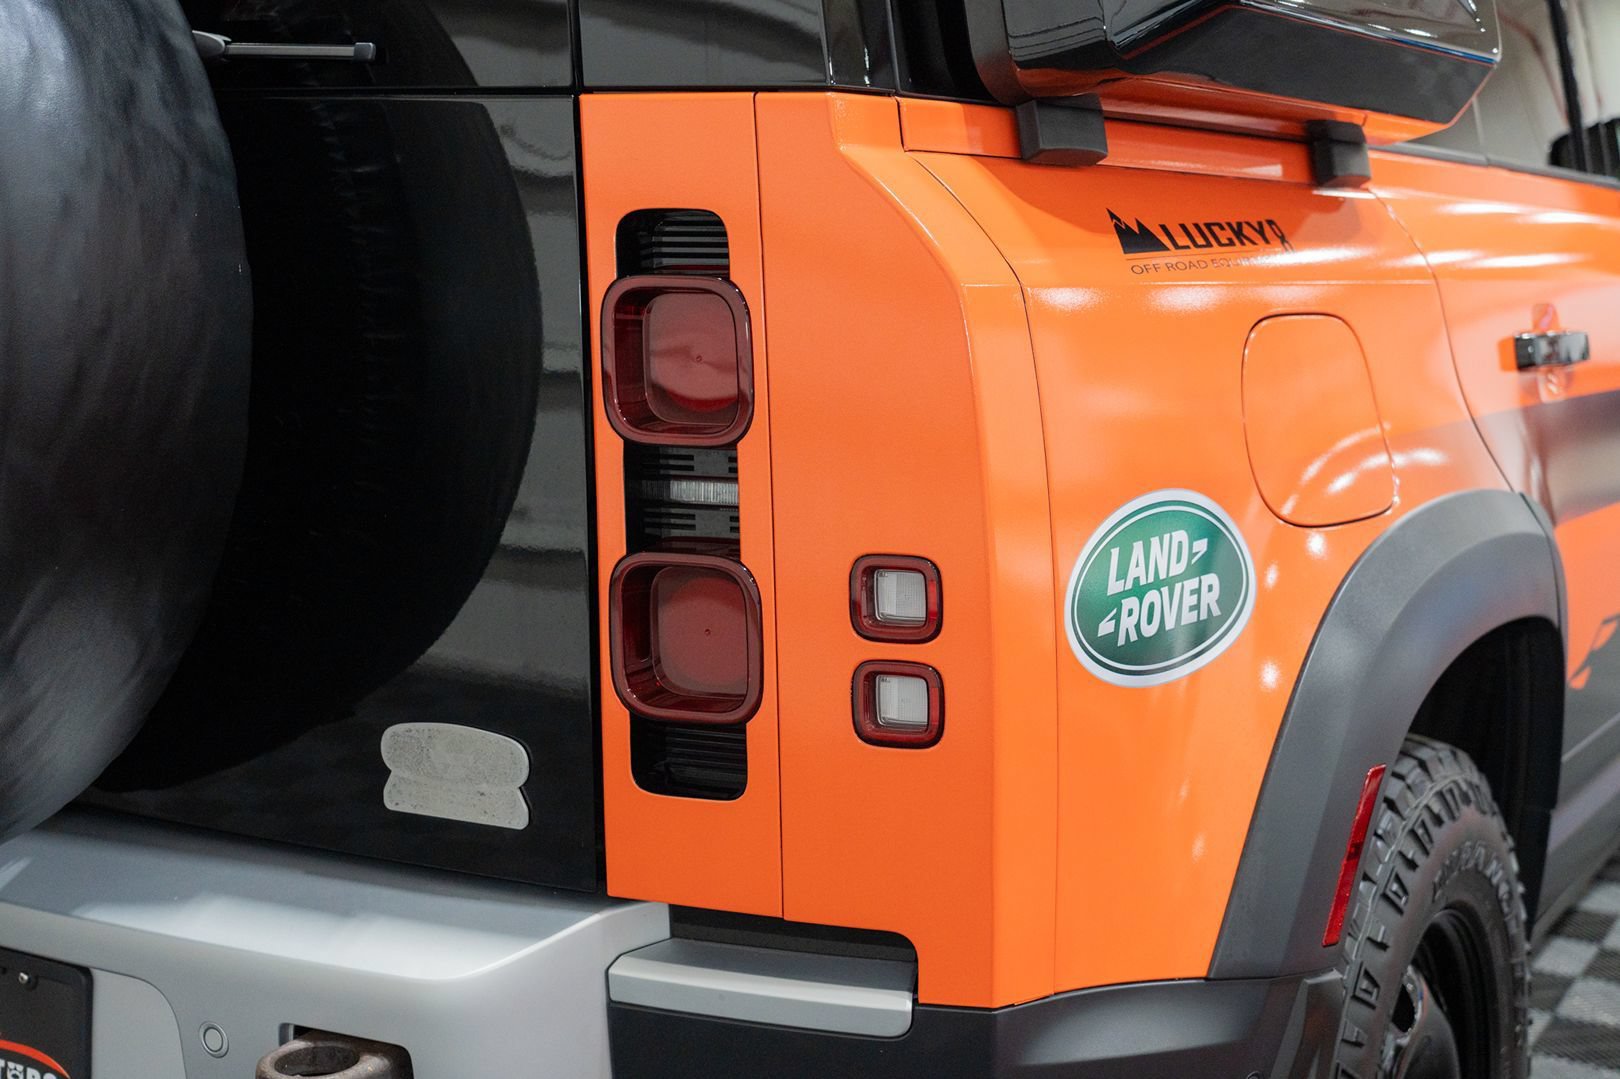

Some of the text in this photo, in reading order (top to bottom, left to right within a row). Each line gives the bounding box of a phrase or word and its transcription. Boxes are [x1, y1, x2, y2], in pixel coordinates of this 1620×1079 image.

[1130, 262, 1162, 275] OFF
[1165, 259, 1209, 273] ROAD
[1106, 529, 1189, 596] LAND
[1117, 572, 1222, 647] ROVER
